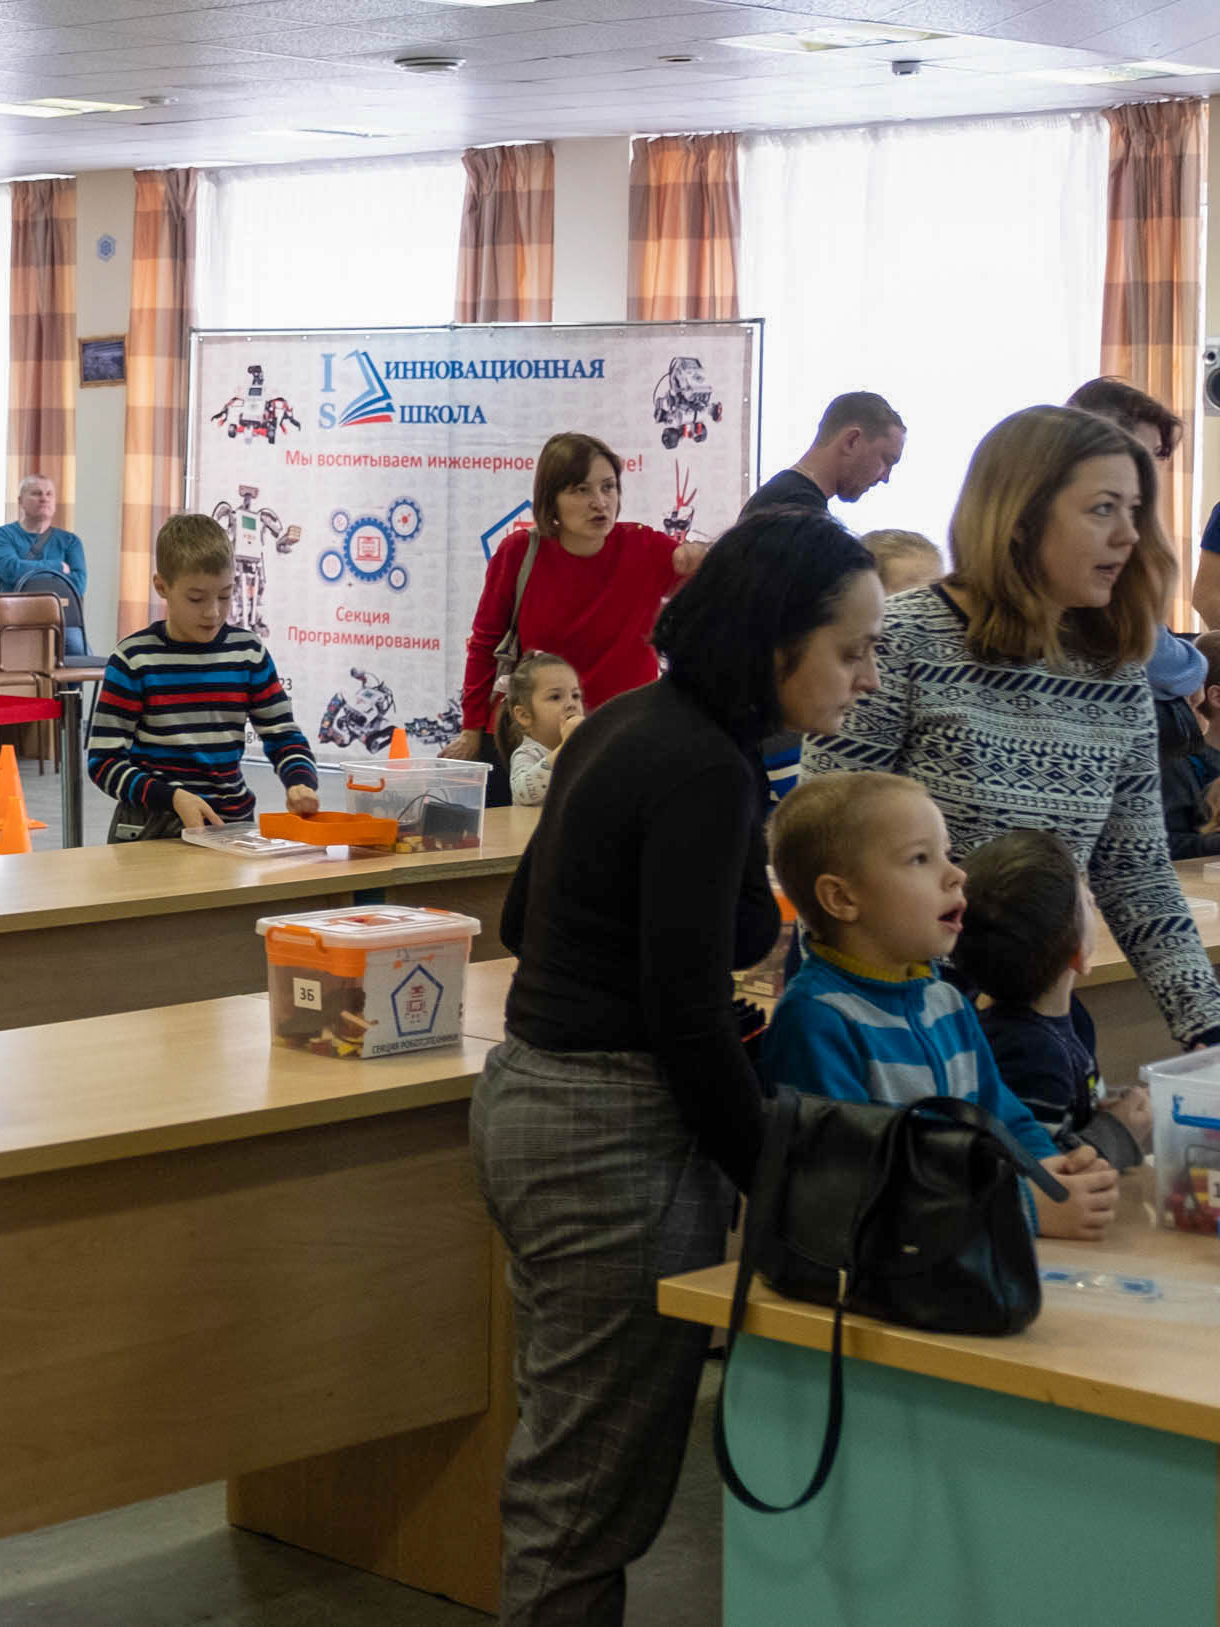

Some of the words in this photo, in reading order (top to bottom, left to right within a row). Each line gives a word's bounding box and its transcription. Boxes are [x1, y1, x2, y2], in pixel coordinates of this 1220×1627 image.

[384, 358, 606, 382] ИННОВАЦИОННАЯ
[399, 404, 488, 425] ШКОЛА
[285, 449, 313, 466] Мы
[317, 452, 423, 471] воспитываем
[427, 455, 535, 473] инженерное
[335, 606, 391, 626] Секция
[287, 626, 441, 651] Программирования
